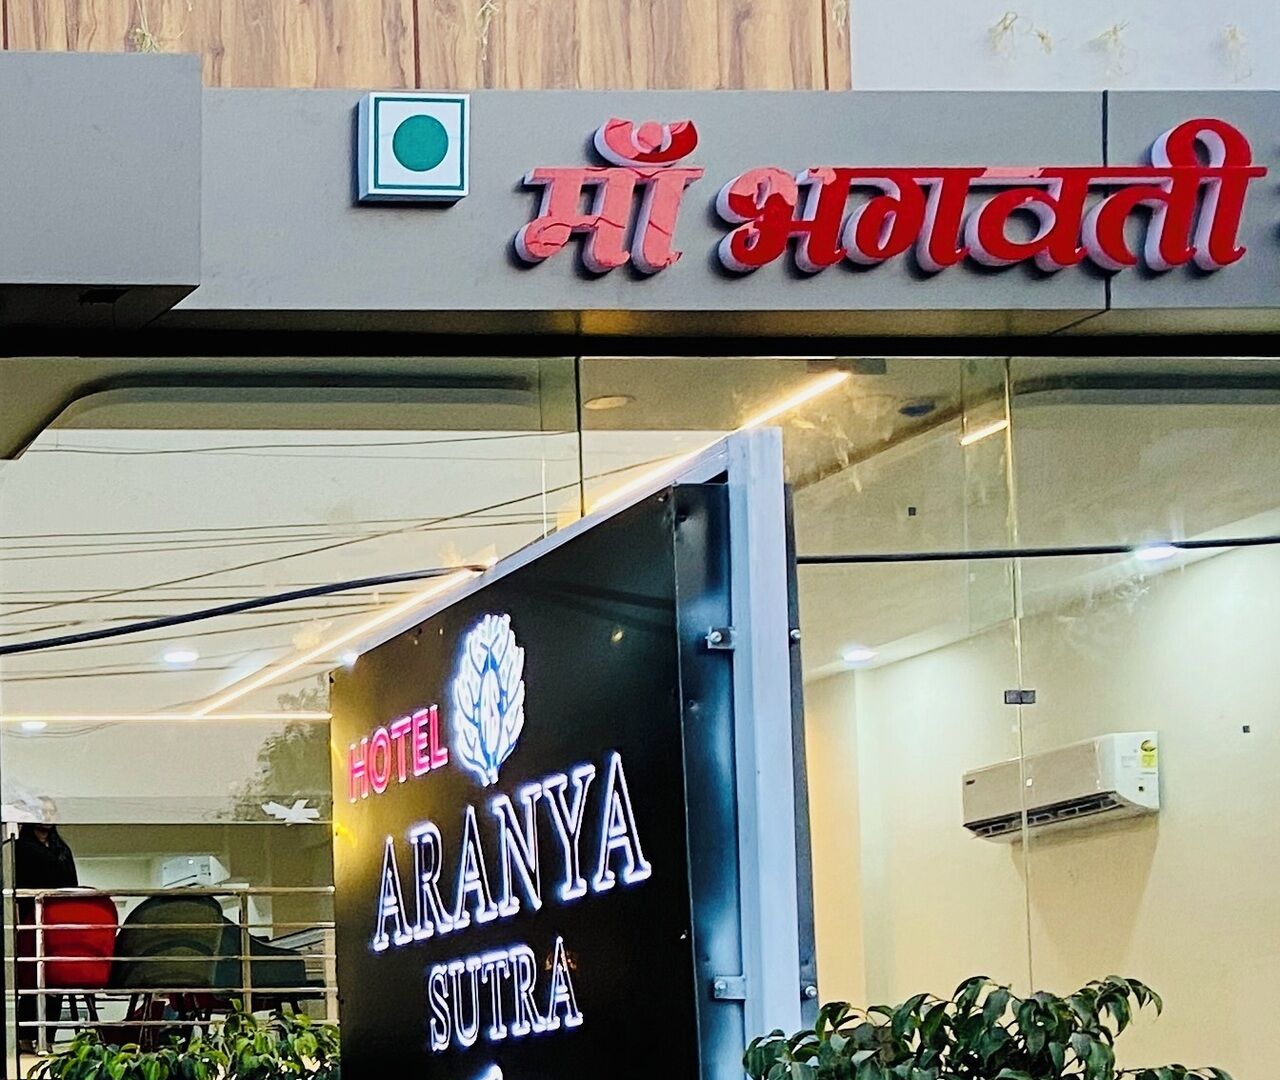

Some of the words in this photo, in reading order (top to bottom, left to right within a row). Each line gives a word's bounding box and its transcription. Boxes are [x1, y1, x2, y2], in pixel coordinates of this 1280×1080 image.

[514, 117, 703, 275] माँ
[716, 118, 1266, 273] भगवती
[345, 705, 448, 802] HOTEL
[372, 751, 652, 951] ARANYA
[426, 936, 583, 1052] SUTRA
